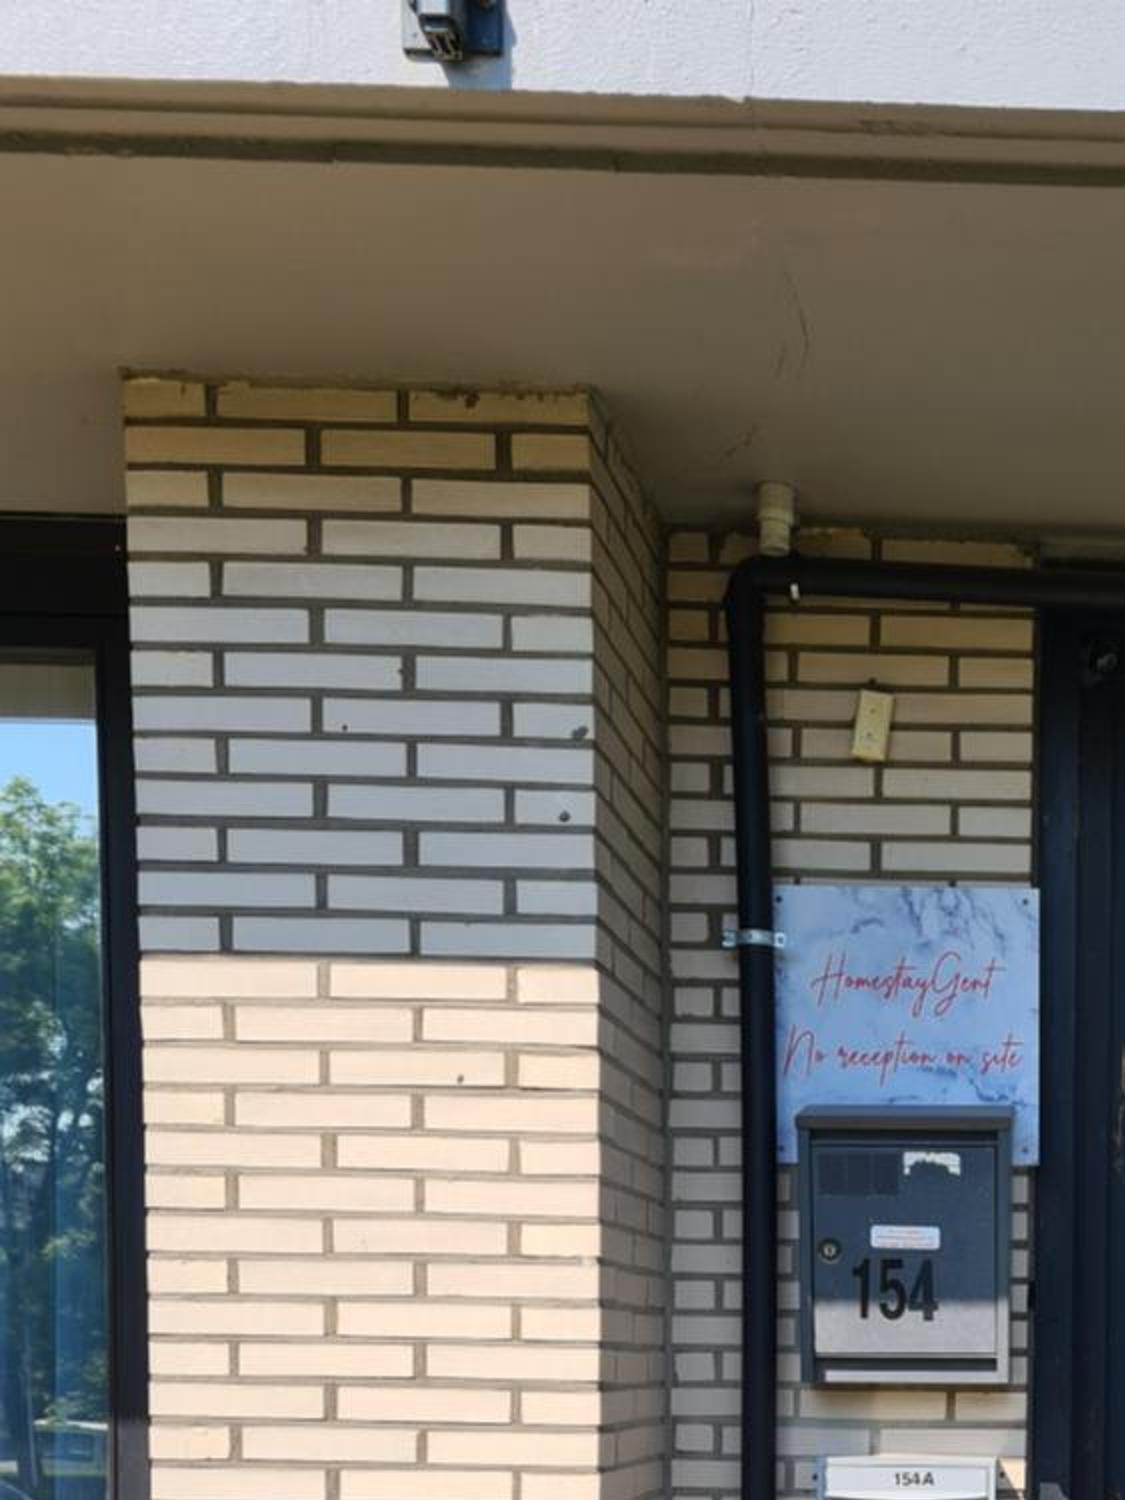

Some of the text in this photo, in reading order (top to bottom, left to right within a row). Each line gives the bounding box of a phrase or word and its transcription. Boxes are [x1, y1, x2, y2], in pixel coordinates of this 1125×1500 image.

[811, 951, 1006, 1018] HomestayGent
[783, 1024, 1024, 1088] No reception on site
[852, 1258, 939, 1321] 154
[894, 1471, 935, 1487] 154A
